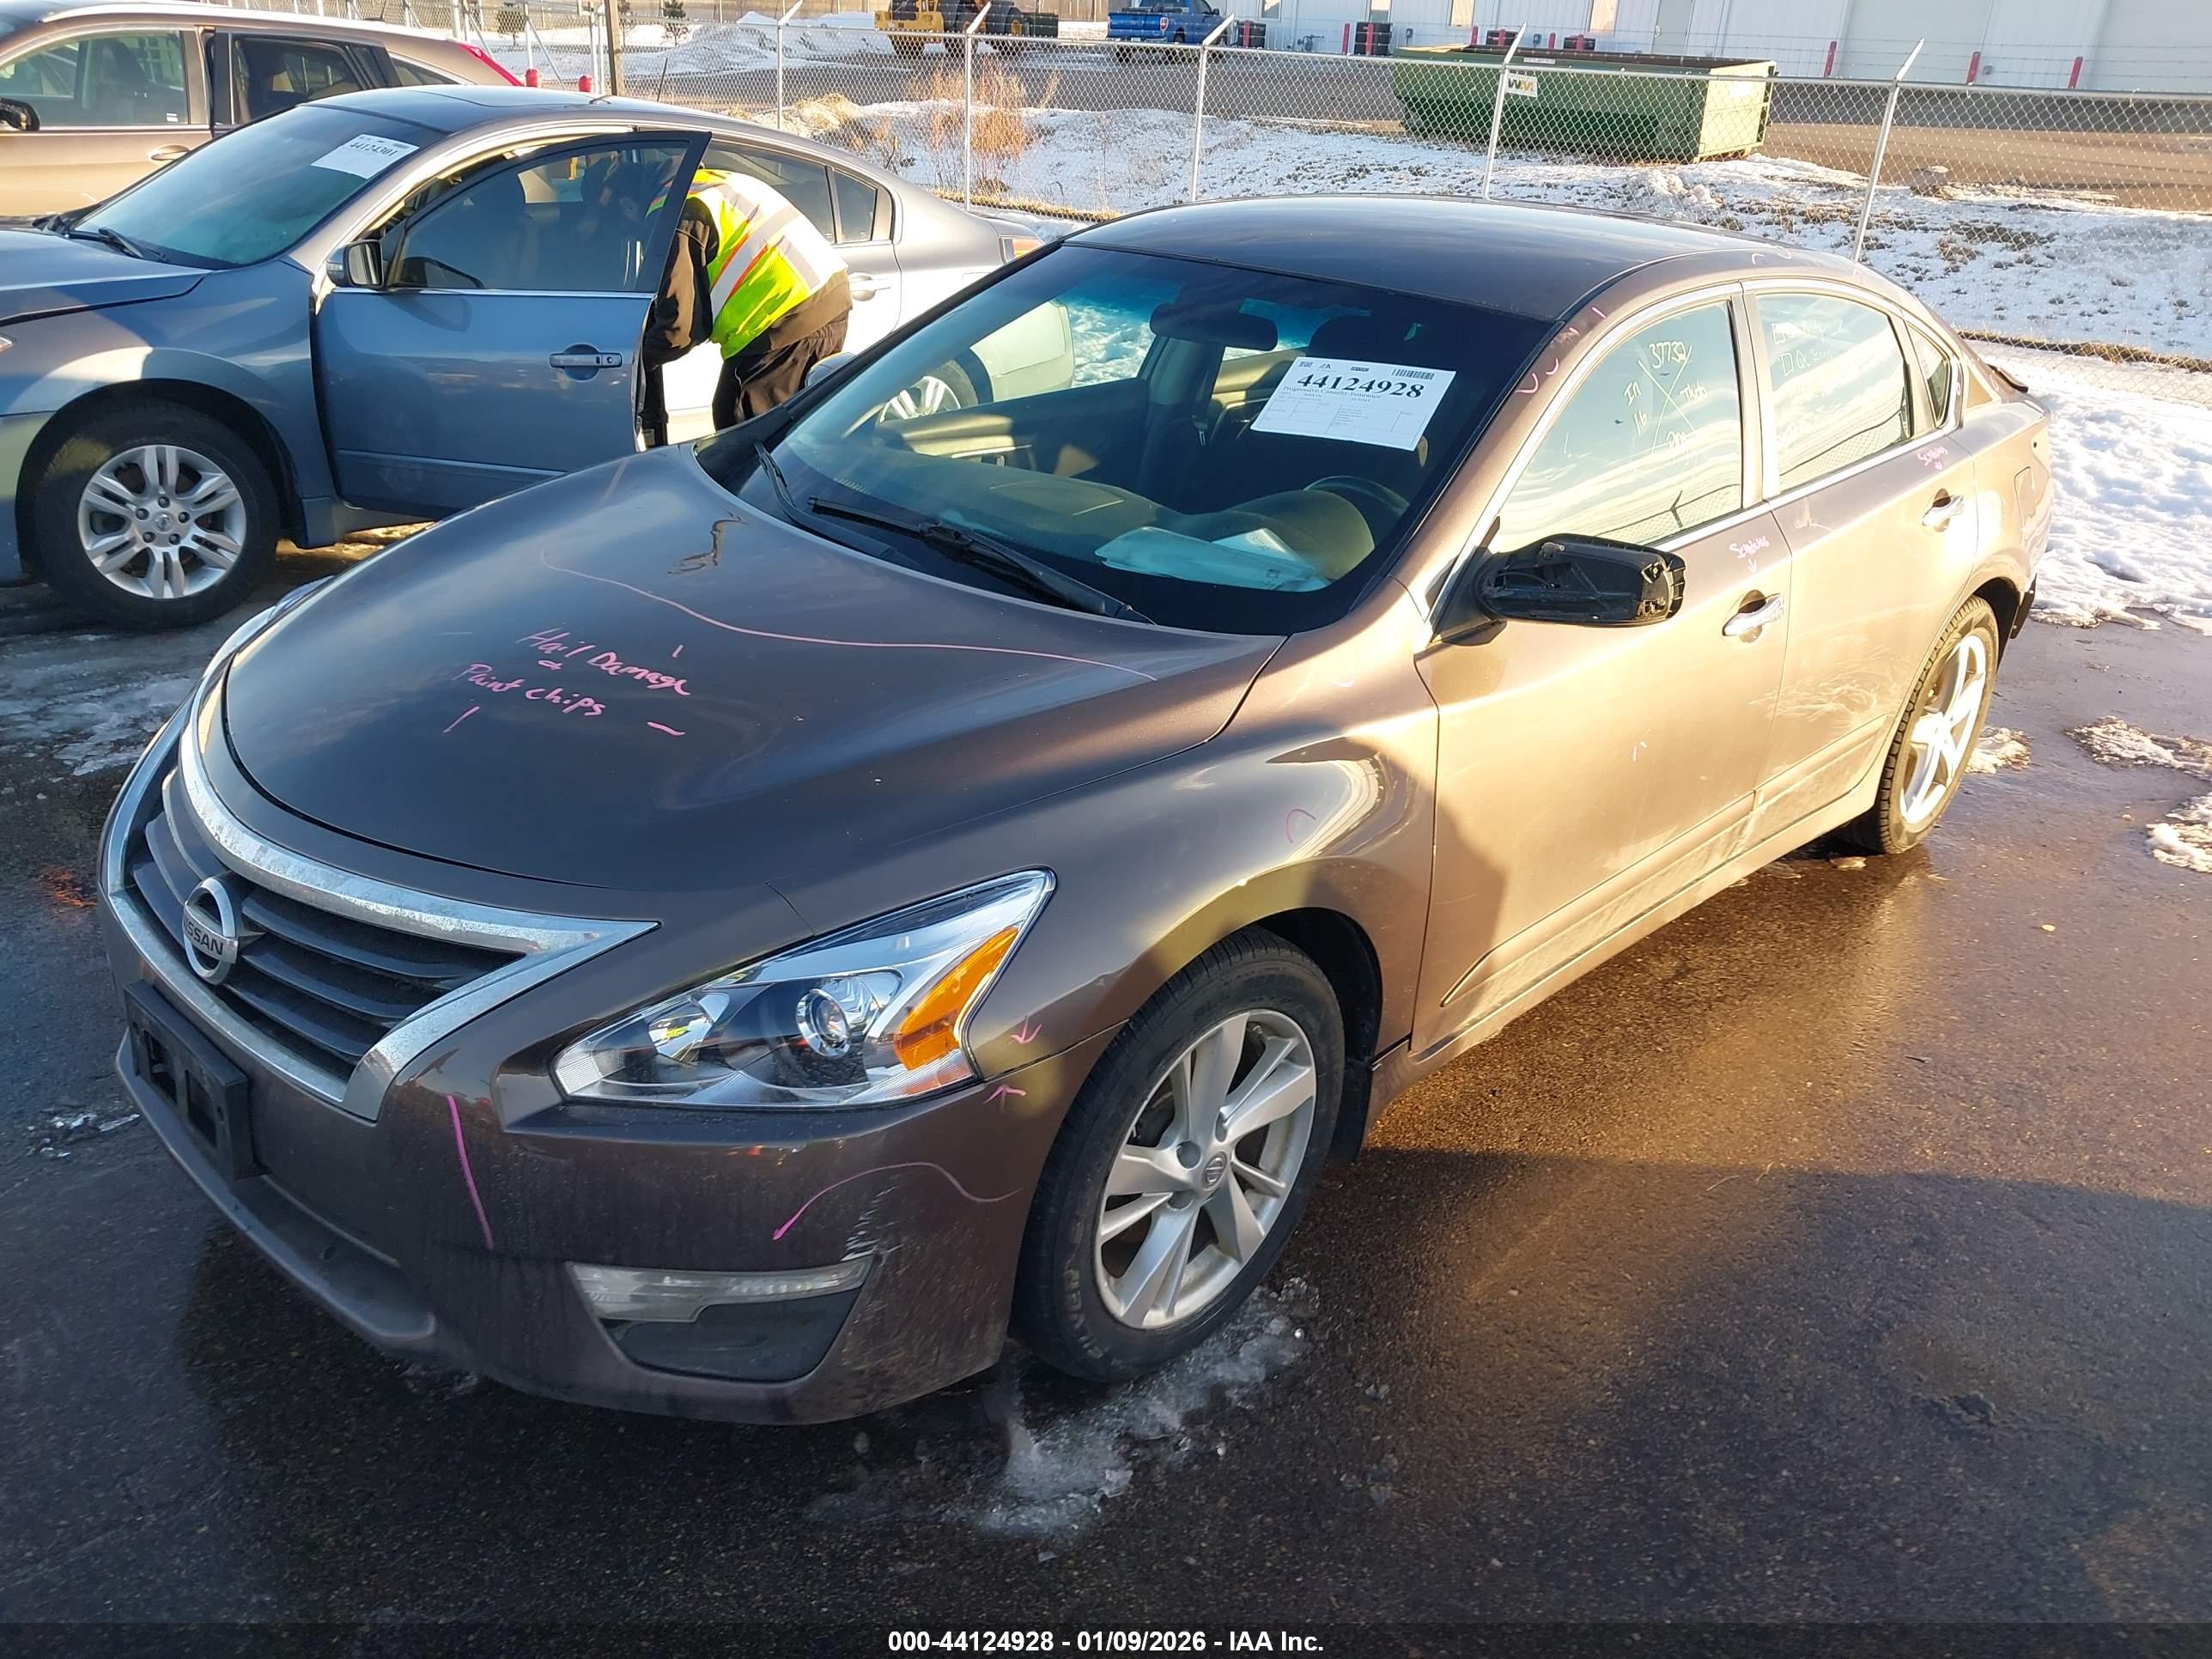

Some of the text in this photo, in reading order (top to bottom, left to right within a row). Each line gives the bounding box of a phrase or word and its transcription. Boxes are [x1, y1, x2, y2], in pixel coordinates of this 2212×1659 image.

[1297, 373, 1425, 398] 44124928
[515, 628, 692, 696] Hail Damage
[453, 663, 526, 693] Paint
